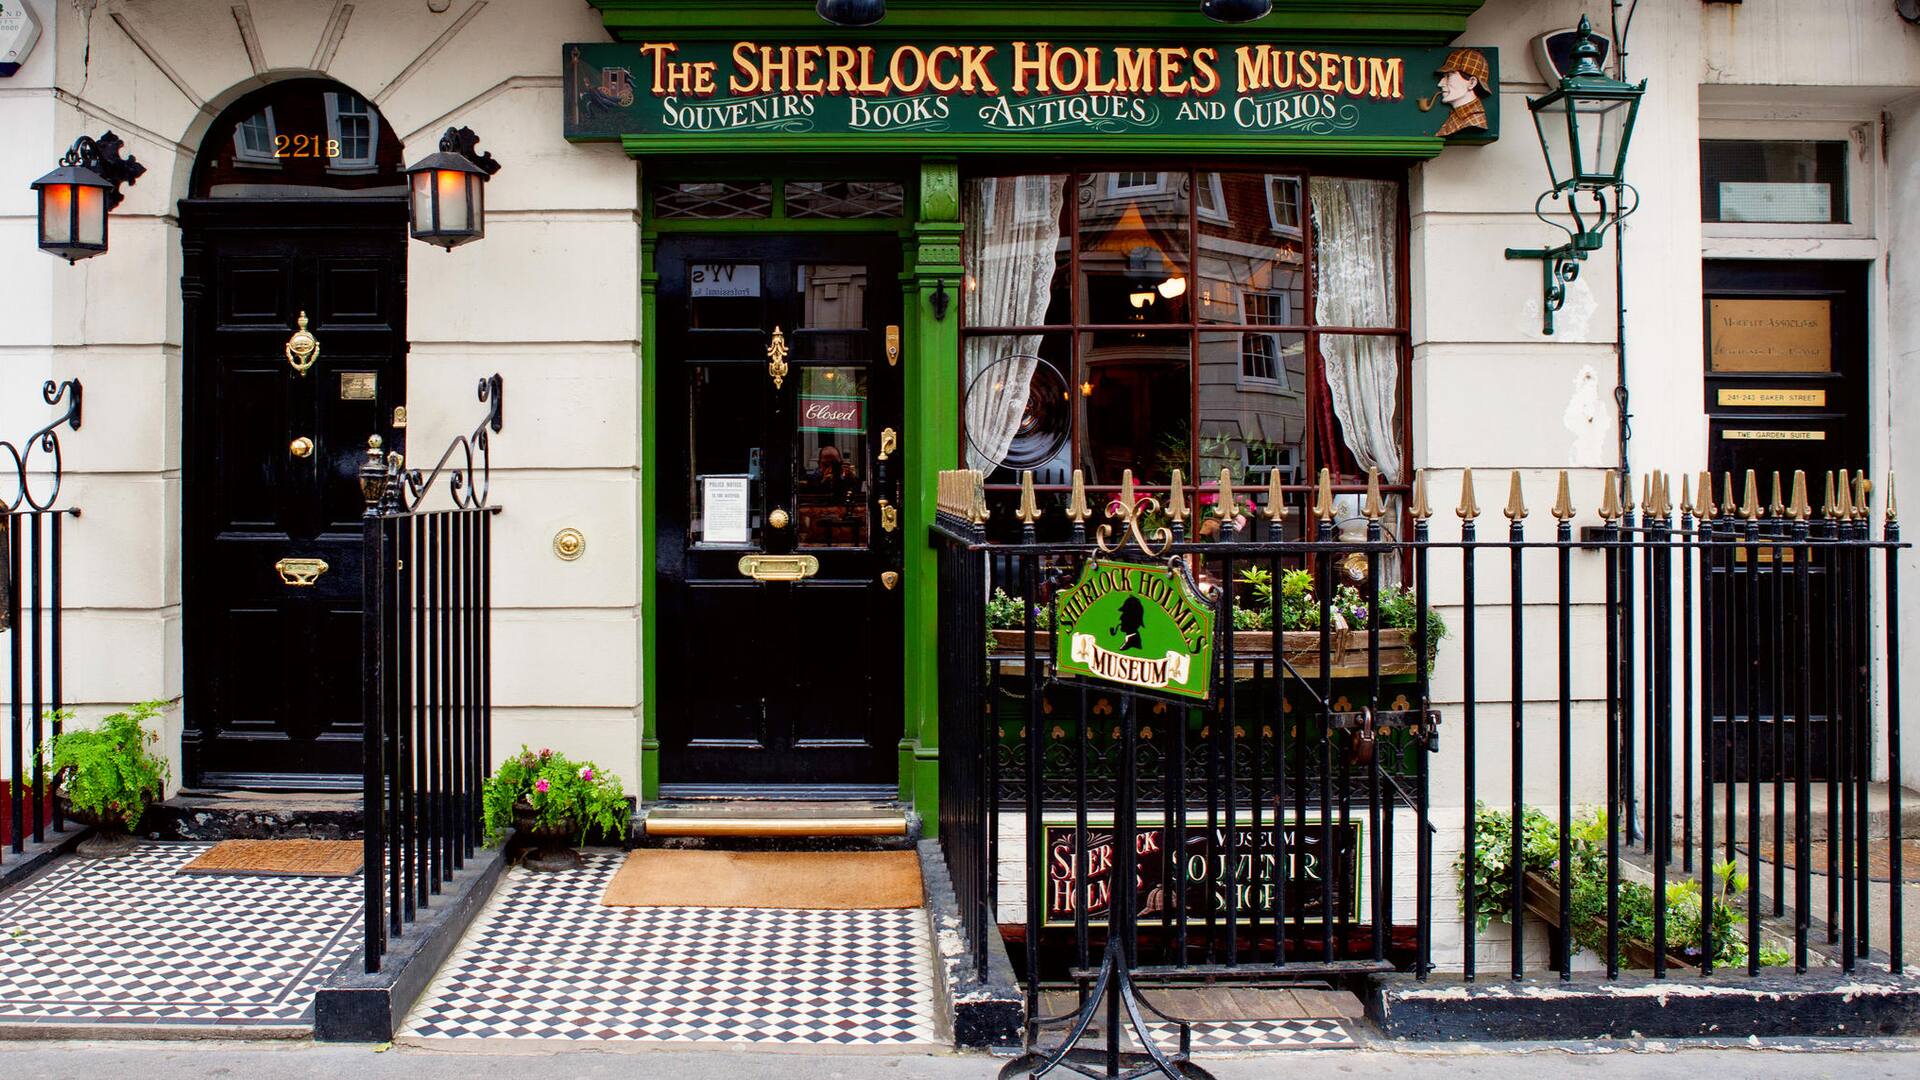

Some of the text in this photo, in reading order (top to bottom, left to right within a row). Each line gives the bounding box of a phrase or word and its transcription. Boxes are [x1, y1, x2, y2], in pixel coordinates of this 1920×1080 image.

[641, 41, 1404, 99] THE SHERLOCK HOLMES MUSEUM
[662, 94, 1335, 130] SOUVENIRS BOOKS ANTIQUES AND CURIOS
[274, 134, 340, 158] 221B
[806, 403, 856, 421] Closed
[1060, 568, 1207, 655] SHERLOCK HOLMES
[1092, 644, 1168, 684] MUSEUM
